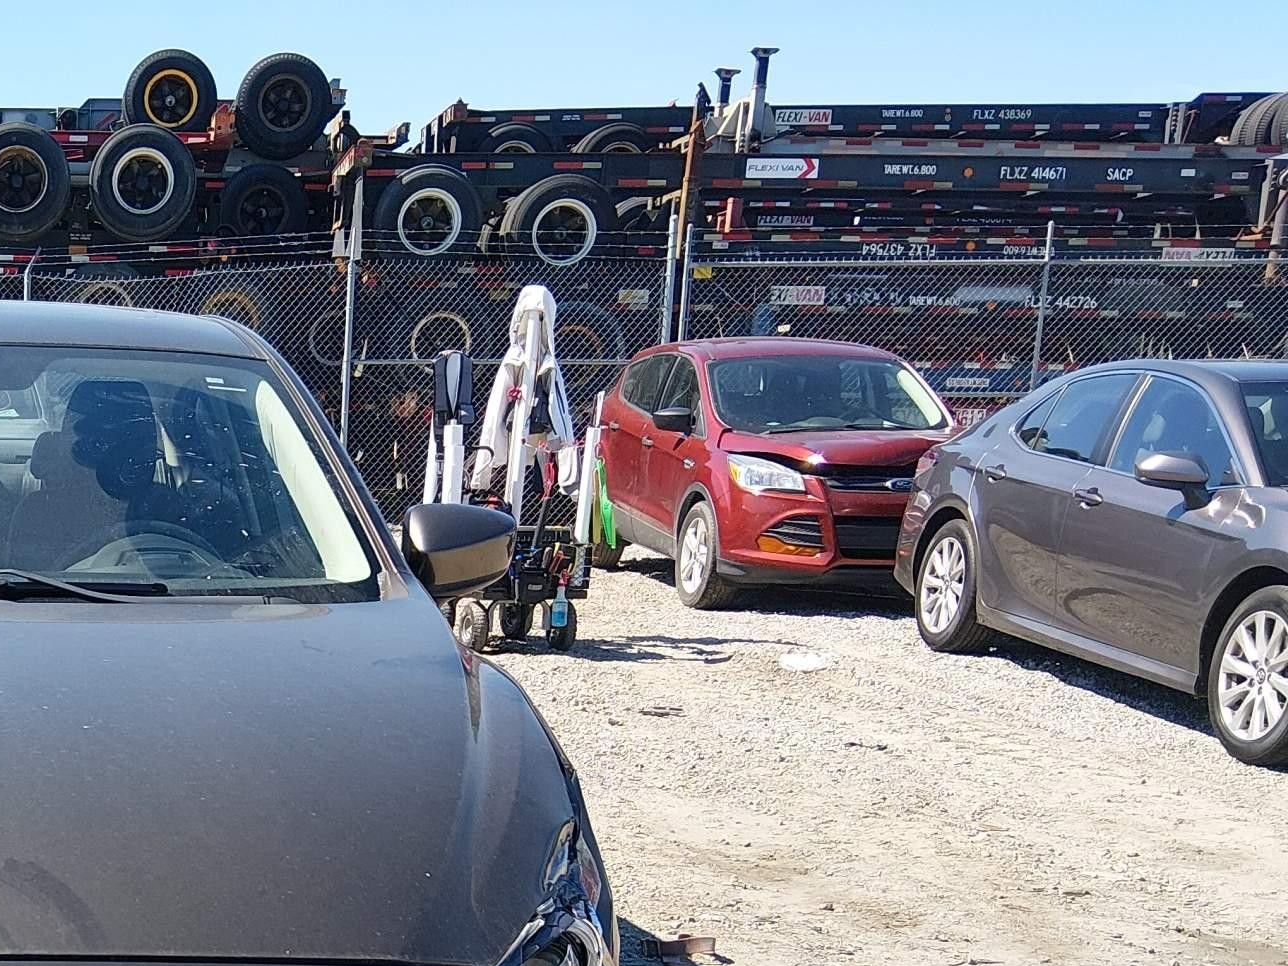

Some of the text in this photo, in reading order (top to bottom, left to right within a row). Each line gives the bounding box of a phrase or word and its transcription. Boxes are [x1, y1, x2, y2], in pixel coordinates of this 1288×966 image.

[775, 110, 831, 123] FLEXI-VAN
[972, 109, 1032, 120] FLXZ 438369
[748, 164, 804, 172] FLEXI VAN
[1000, 166, 1067, 180] FLXZ 414671
[1106, 168, 1134, 180] SACP
[862, 243, 937, 257] FLXZ 437564
